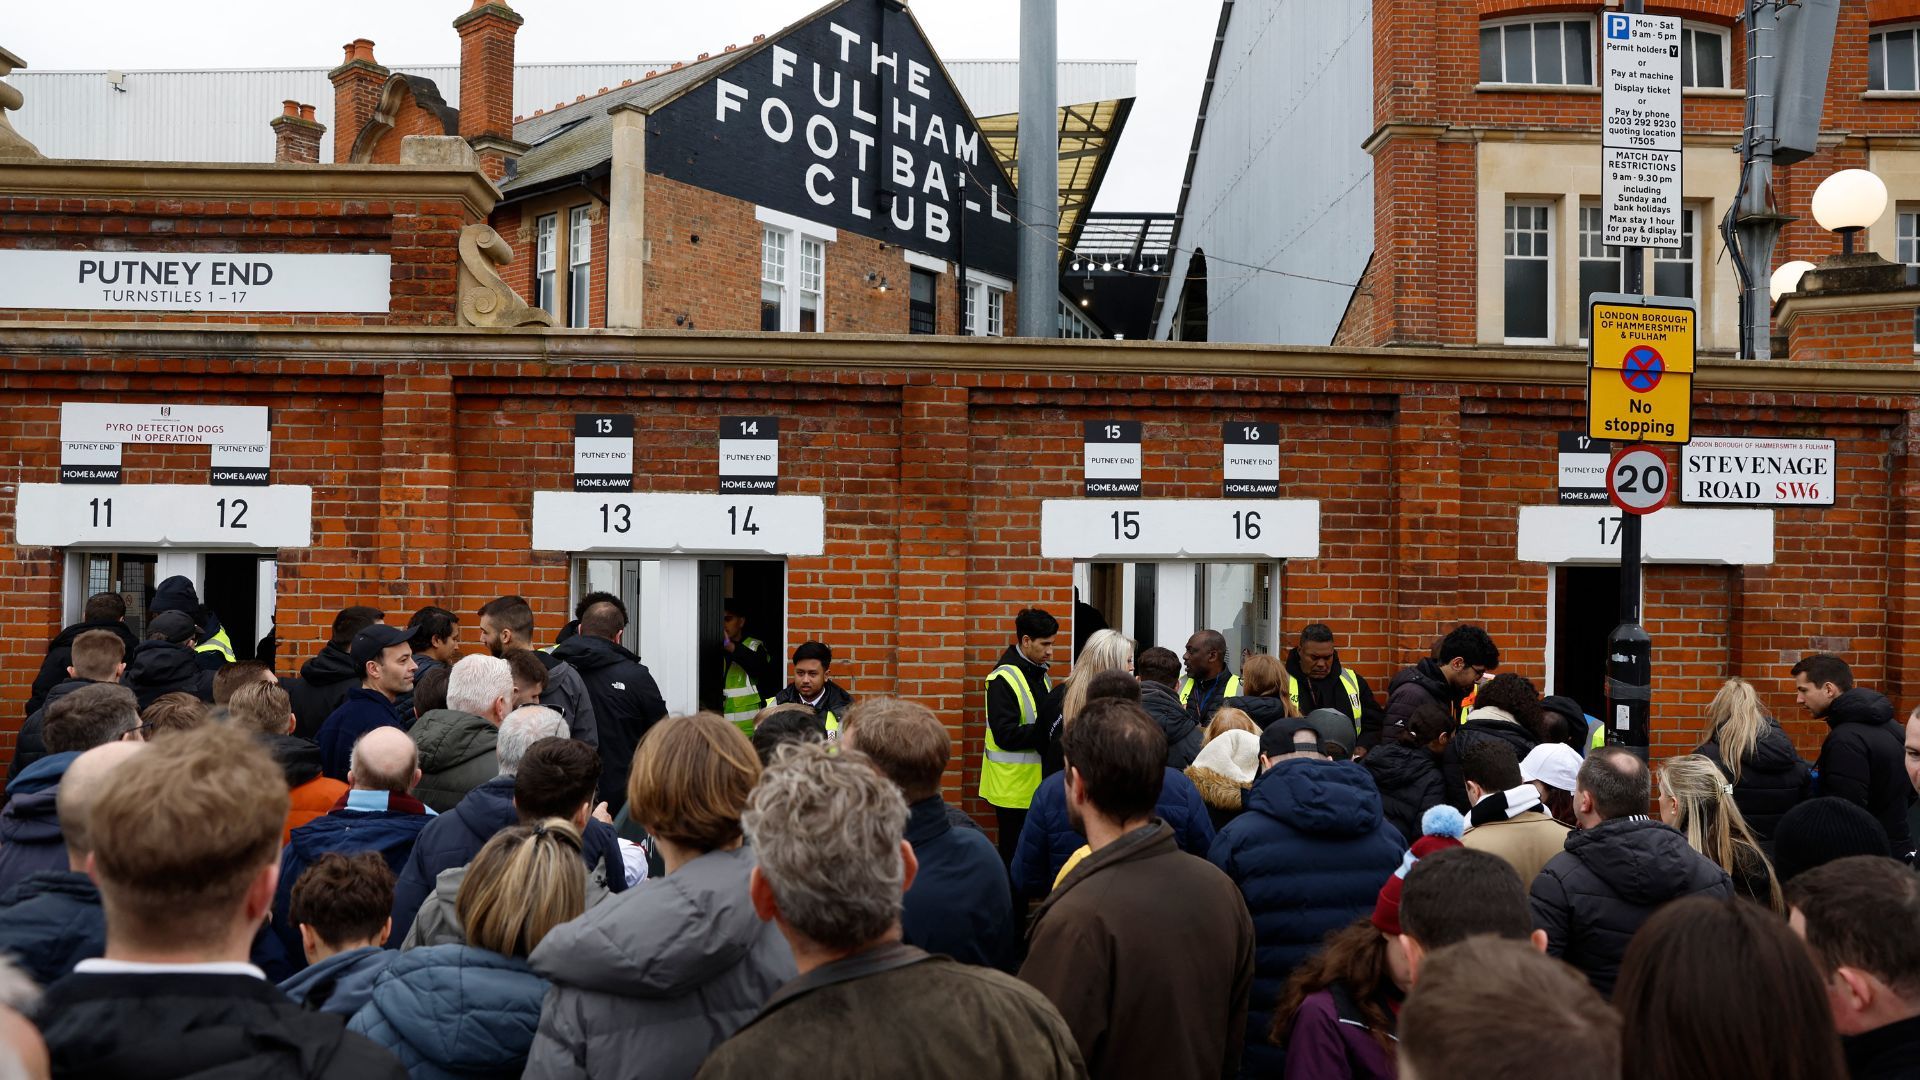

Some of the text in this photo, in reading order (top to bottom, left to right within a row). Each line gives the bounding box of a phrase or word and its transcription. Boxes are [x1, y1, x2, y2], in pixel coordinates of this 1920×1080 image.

[1635, 20, 1653, 28] Mon
[1659, 21, 1674, 30] Sat
[1606, 43, 1634, 52] Permit
[1636, 45, 1667, 54] holders
[830, 21, 930, 100] THE
[1611, 69, 1626, 79] Pay
[1639, 72, 1674, 81] machine
[1614, 83, 1671, 95] Display ticket
[772, 44, 979, 167] FULHAM
[1615, 107, 1670, 119] Pay by phone
[1608, 117, 1677, 128] 0203 292 9230
[1608, 127, 1676, 138] quoting location
[1629, 137, 1655, 146] 17505
[1616, 151, 1669, 162] MATCH DAY
[1608, 160, 1676, 172] RESTRICTIONS
[1612, 172, 1618, 180] 9
[1638, 174, 1658, 182] 9.30
[1659, 176, 1672, 184] pm
[1623, 185, 1661, 195] including
[805, 163, 951, 243] CLUB
[1618, 194, 1667, 204] Sunday and
[1613, 203, 1671, 214] bank holidays
[1609, 215, 1675, 225] Max stay 1 hour
[1607, 224, 1620, 232] for
[1622, 226, 1637, 234] pay
[1647, 226, 1677, 236] display
[1641, 235, 1651, 244] by
[1654, 236, 1679, 244] phone
[79, 260, 274, 286] PUTNEY END
[103, 290, 202, 303] TURNSTILES
[1599, 311, 1688, 323] LONDON BOROUGH
[1616, 321, 1686, 333] HAMMERSMITH
[1620, 331, 1667, 341] & FULHAM
[1629, 399, 1652, 414] No
[106, 423, 224, 433] PYRO DETECTION DOGS
[595, 419, 613, 433] 13
[740, 421, 759, 435] 14
[1104, 425, 1121, 439] 15
[1604, 417, 1675, 436] stopping
[131, 433, 203, 442] IN OPERATION
[1243, 426, 1260, 440] 16
[1689, 455, 1827, 475] STEVENAGE
[1617, 465, 1664, 494] 20
[1698, 481, 1820, 500] ROAD SW6
[90, 498, 112, 528] 11
[216, 498, 248, 528] 12
[600, 503, 631, 533] 13
[728, 506, 759, 535] 14
[1111, 511, 1140, 540] 15
[1232, 511, 1261, 540] 16
[1598, 517, 1623, 545] 17
